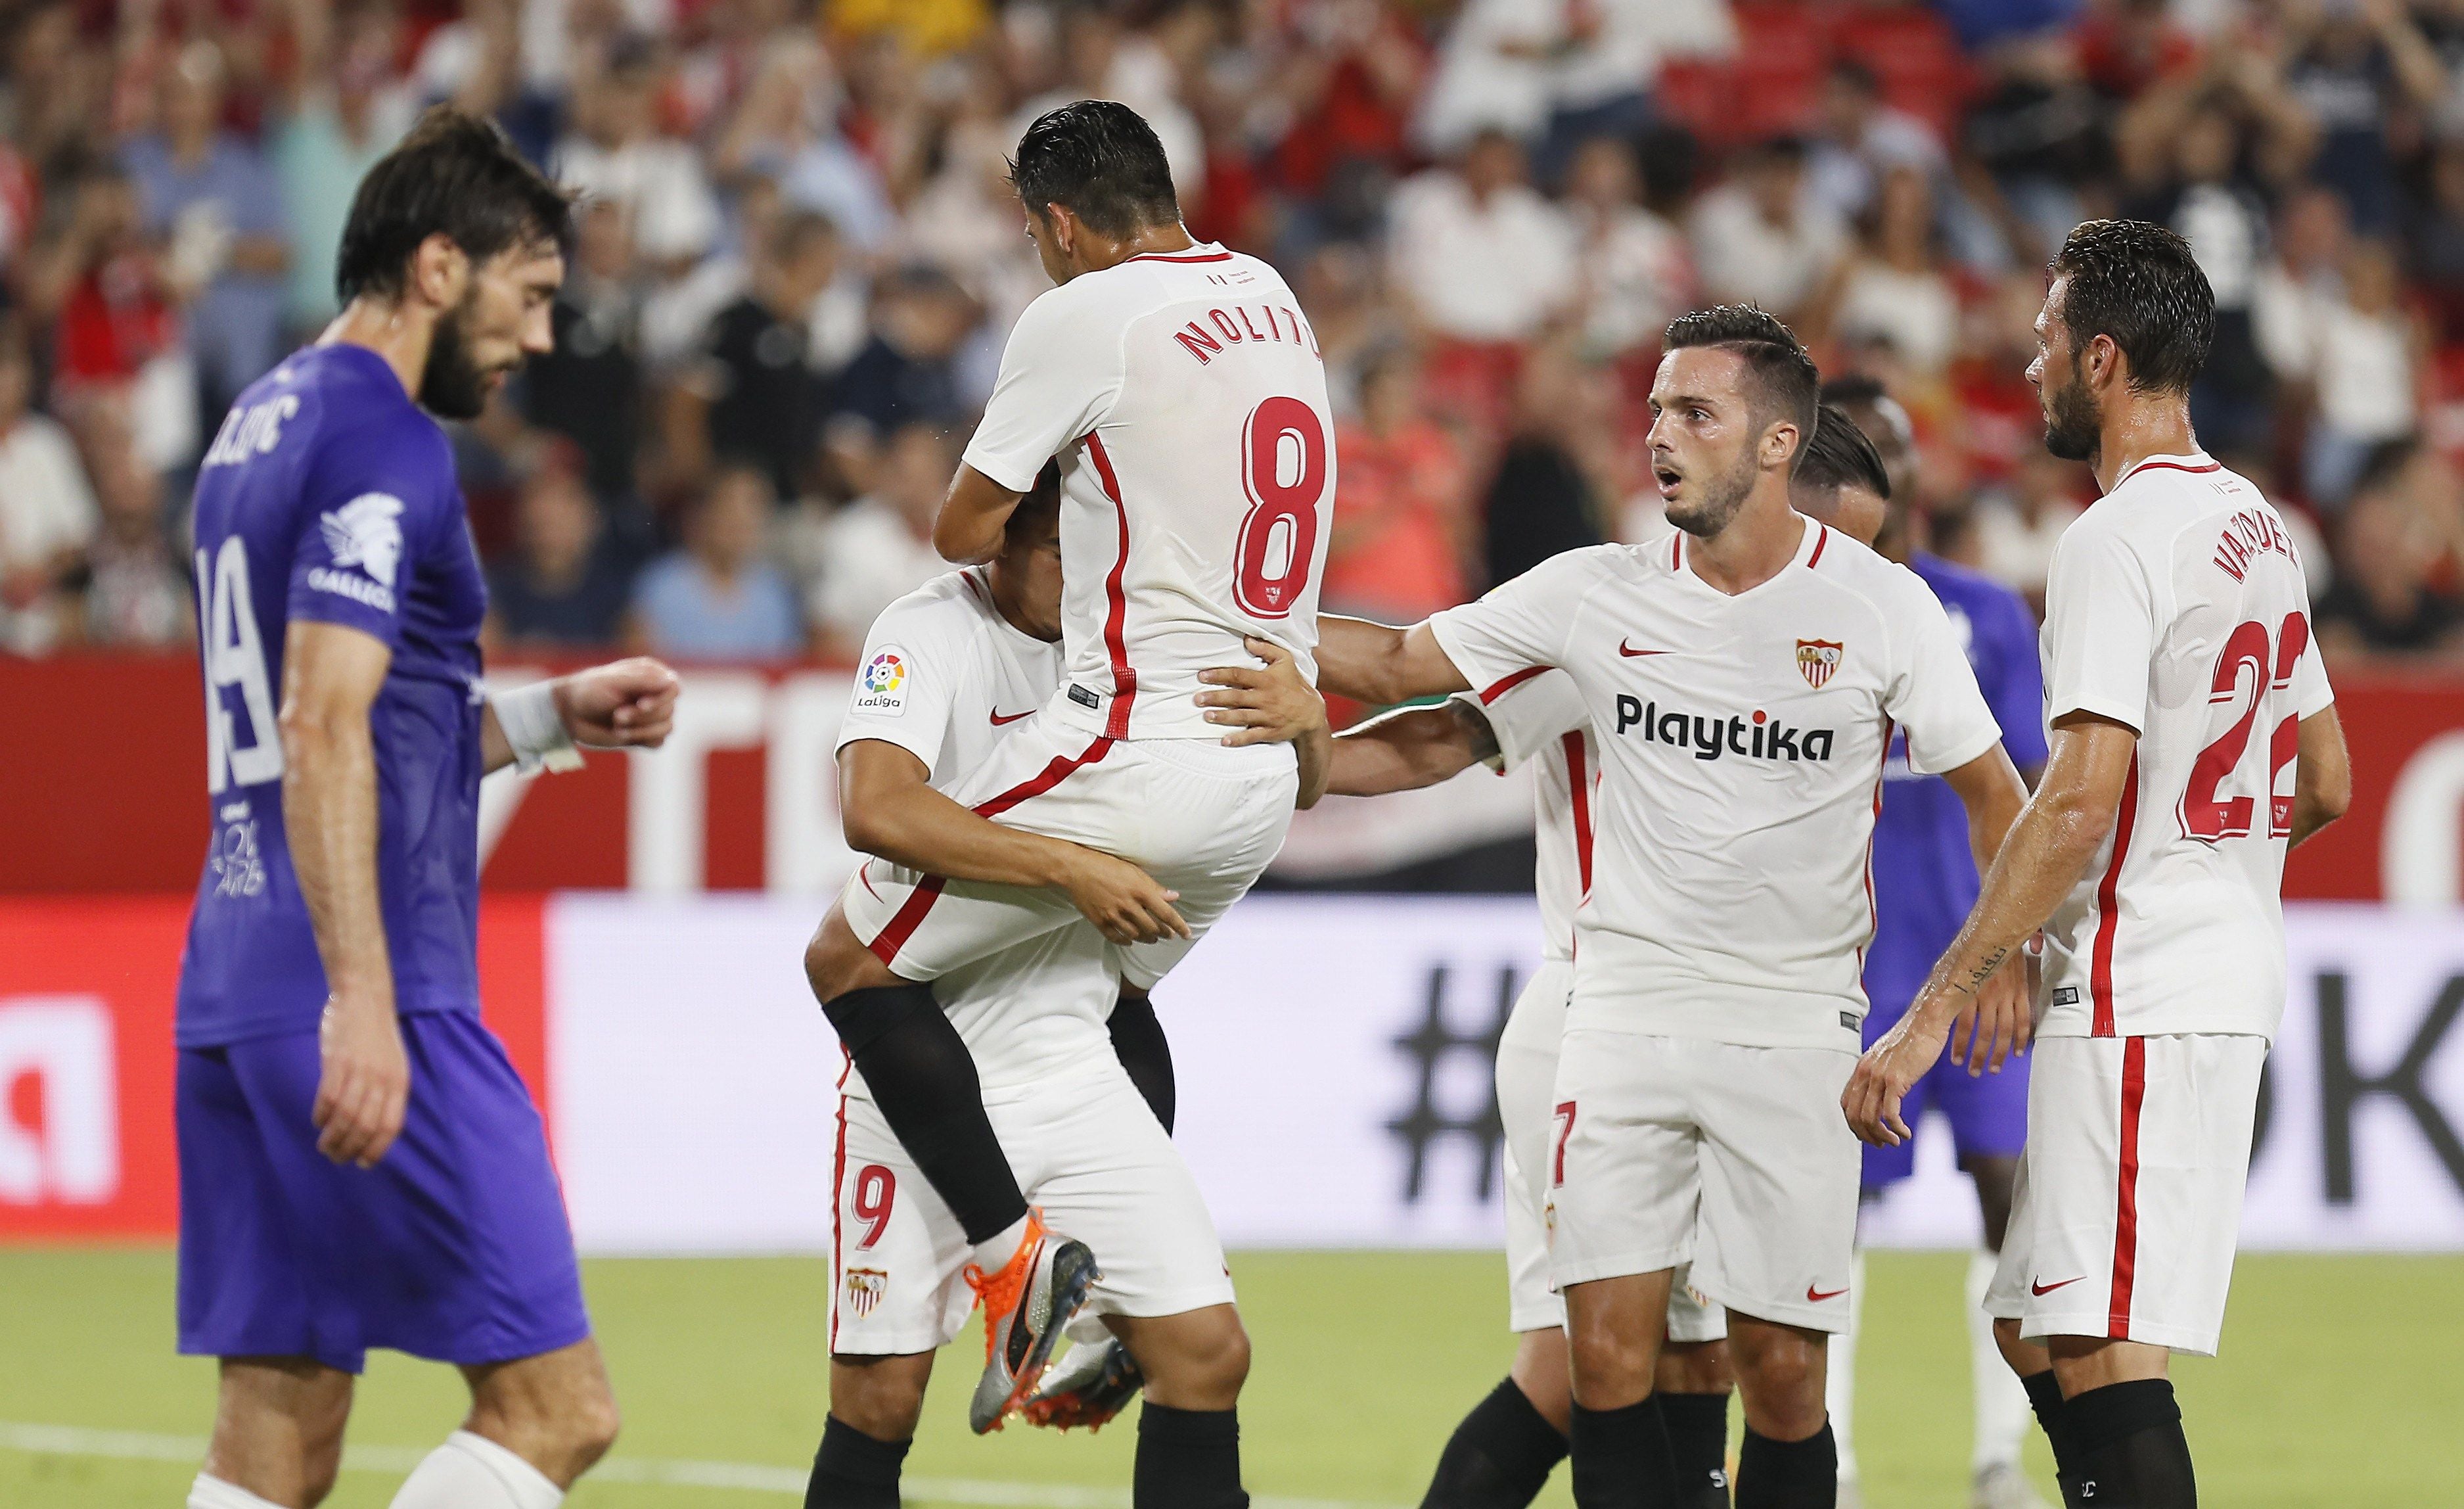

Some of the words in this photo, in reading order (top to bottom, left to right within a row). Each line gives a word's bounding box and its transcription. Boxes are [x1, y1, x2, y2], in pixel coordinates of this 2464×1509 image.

[1233, 397, 1325, 619] 8
[195, 534, 285, 795] 19
[857, 695, 900, 707] LaLiga
[1616, 693, 1834, 760] Playtika
[2176, 612, 2308, 843] 22
[1553, 1100, 1576, 1189] 7
[851, 1164, 896, 1252] 9
